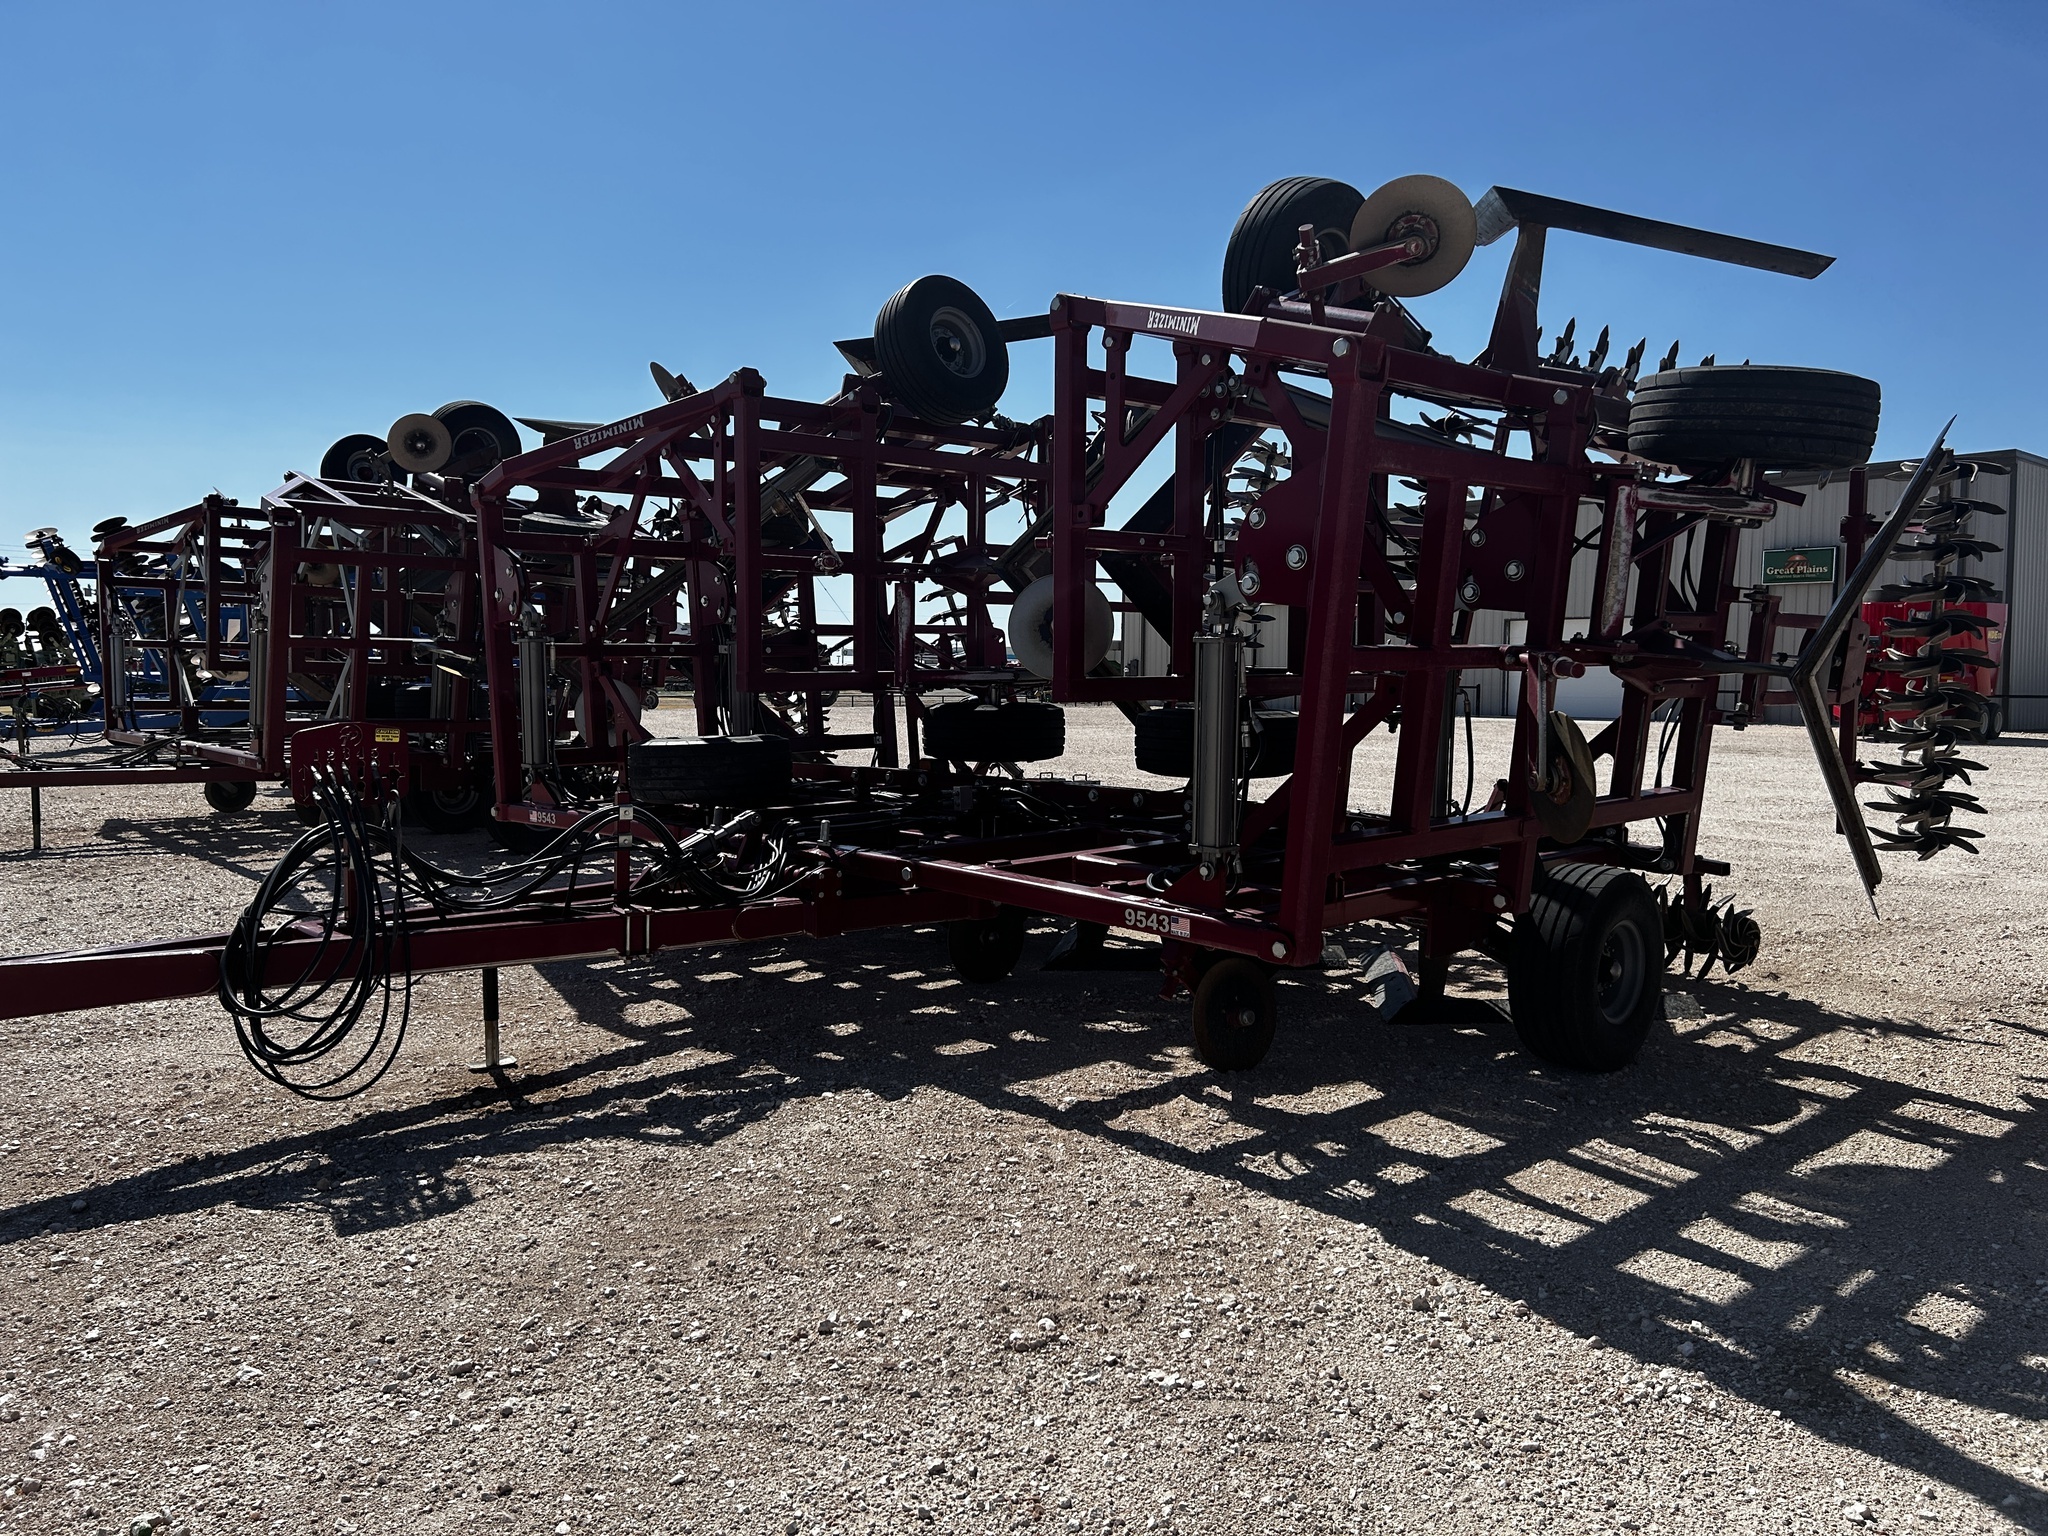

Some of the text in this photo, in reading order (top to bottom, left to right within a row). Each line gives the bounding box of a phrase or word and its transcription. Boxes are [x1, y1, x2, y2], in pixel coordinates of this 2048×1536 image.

[1147, 310, 1201, 336] MINIMIZER
[573, 415, 645, 450] MINIMIZER
[1766, 564, 1828, 575] Great Plains
[537, 811, 556, 825] 9543
[1124, 908, 1170, 933] 9543
